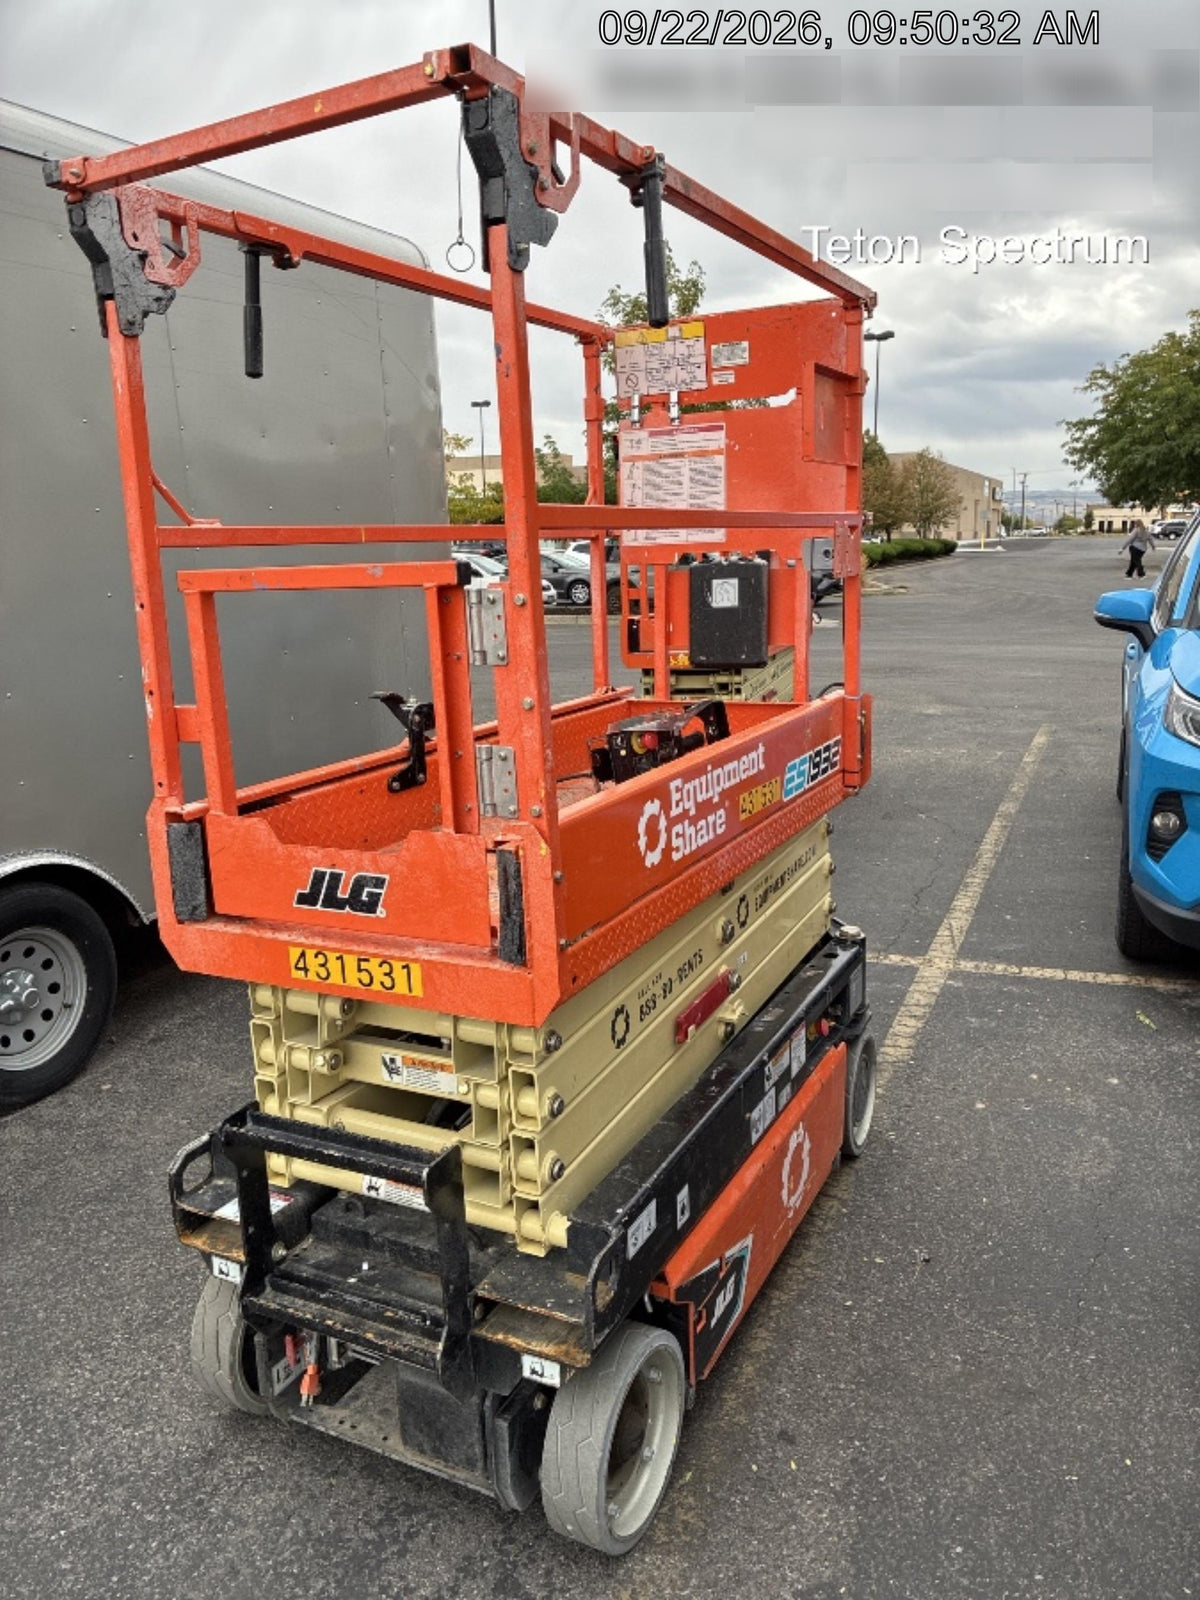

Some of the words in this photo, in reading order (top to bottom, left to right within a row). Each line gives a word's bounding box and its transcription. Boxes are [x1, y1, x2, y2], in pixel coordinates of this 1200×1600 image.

[669, 743, 766, 818] Equipment
[671, 806, 726, 862] Share
[293, 867, 389, 916] JLG
[294, 949, 413, 993] 431531
